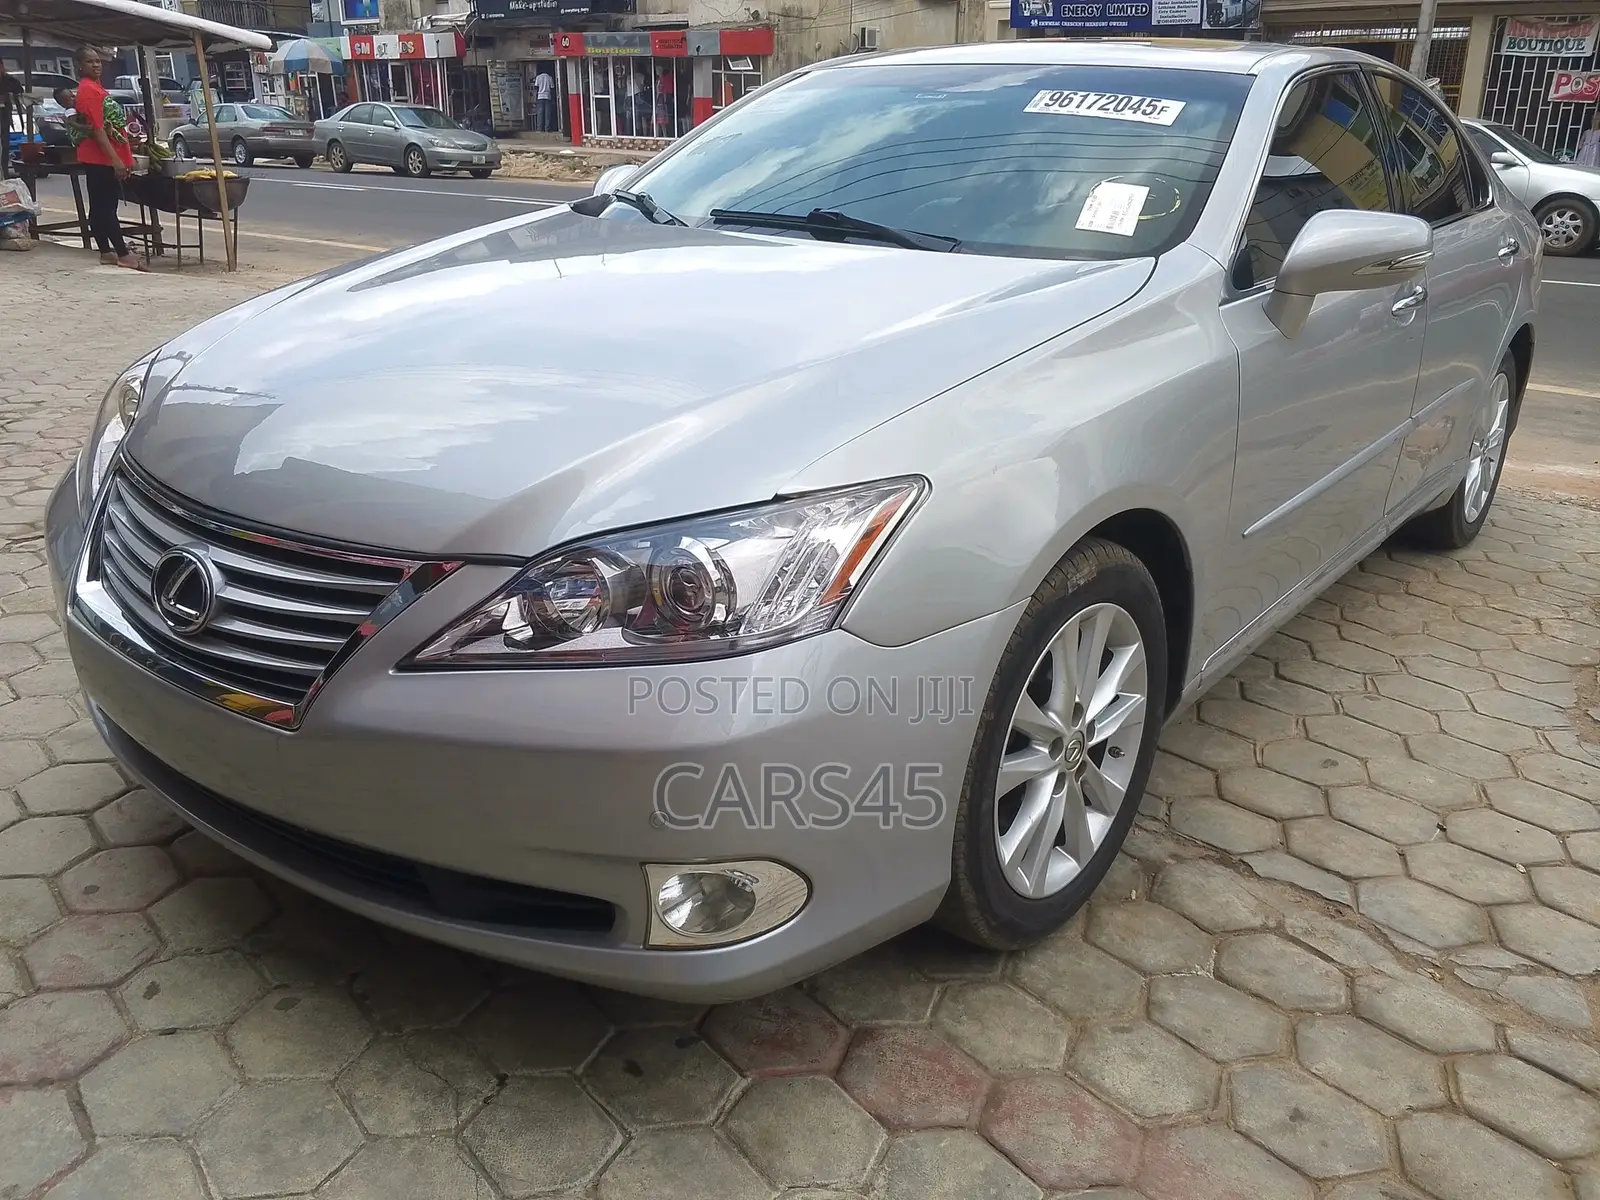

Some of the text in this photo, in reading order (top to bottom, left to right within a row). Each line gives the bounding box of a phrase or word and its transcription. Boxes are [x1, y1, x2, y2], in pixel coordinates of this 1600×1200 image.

[1061, 3, 1149, 17] ENERGY LIMITED
[588, 46, 641, 55] Boutique
[1506, 36, 1586, 54] BOUTIQUE
